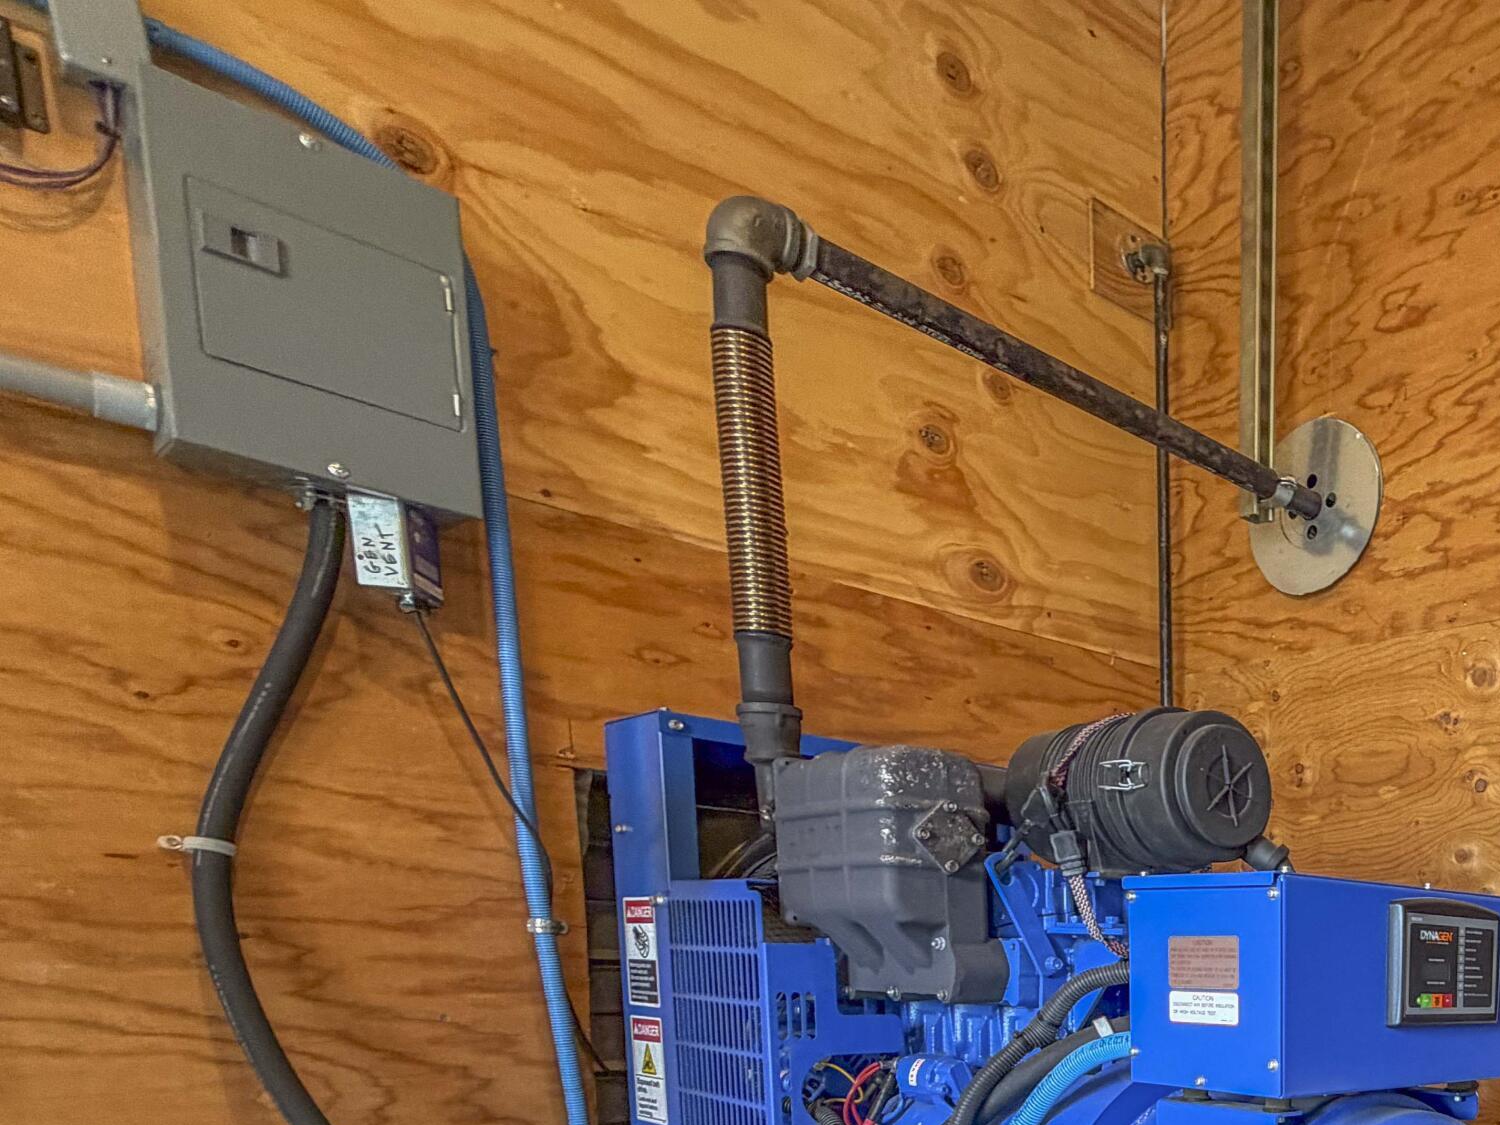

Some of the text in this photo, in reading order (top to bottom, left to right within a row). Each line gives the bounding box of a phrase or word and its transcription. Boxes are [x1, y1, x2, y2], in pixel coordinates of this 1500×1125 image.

[361, 536, 381, 574] GEN
[374, 522, 400, 577] VENT
[631, 905, 653, 918] DANGER
[1420, 929, 1453, 942] DYNAGEN
[1192, 994, 1215, 1002] CAUTION
[637, 1023, 660, 1037] DANGER
